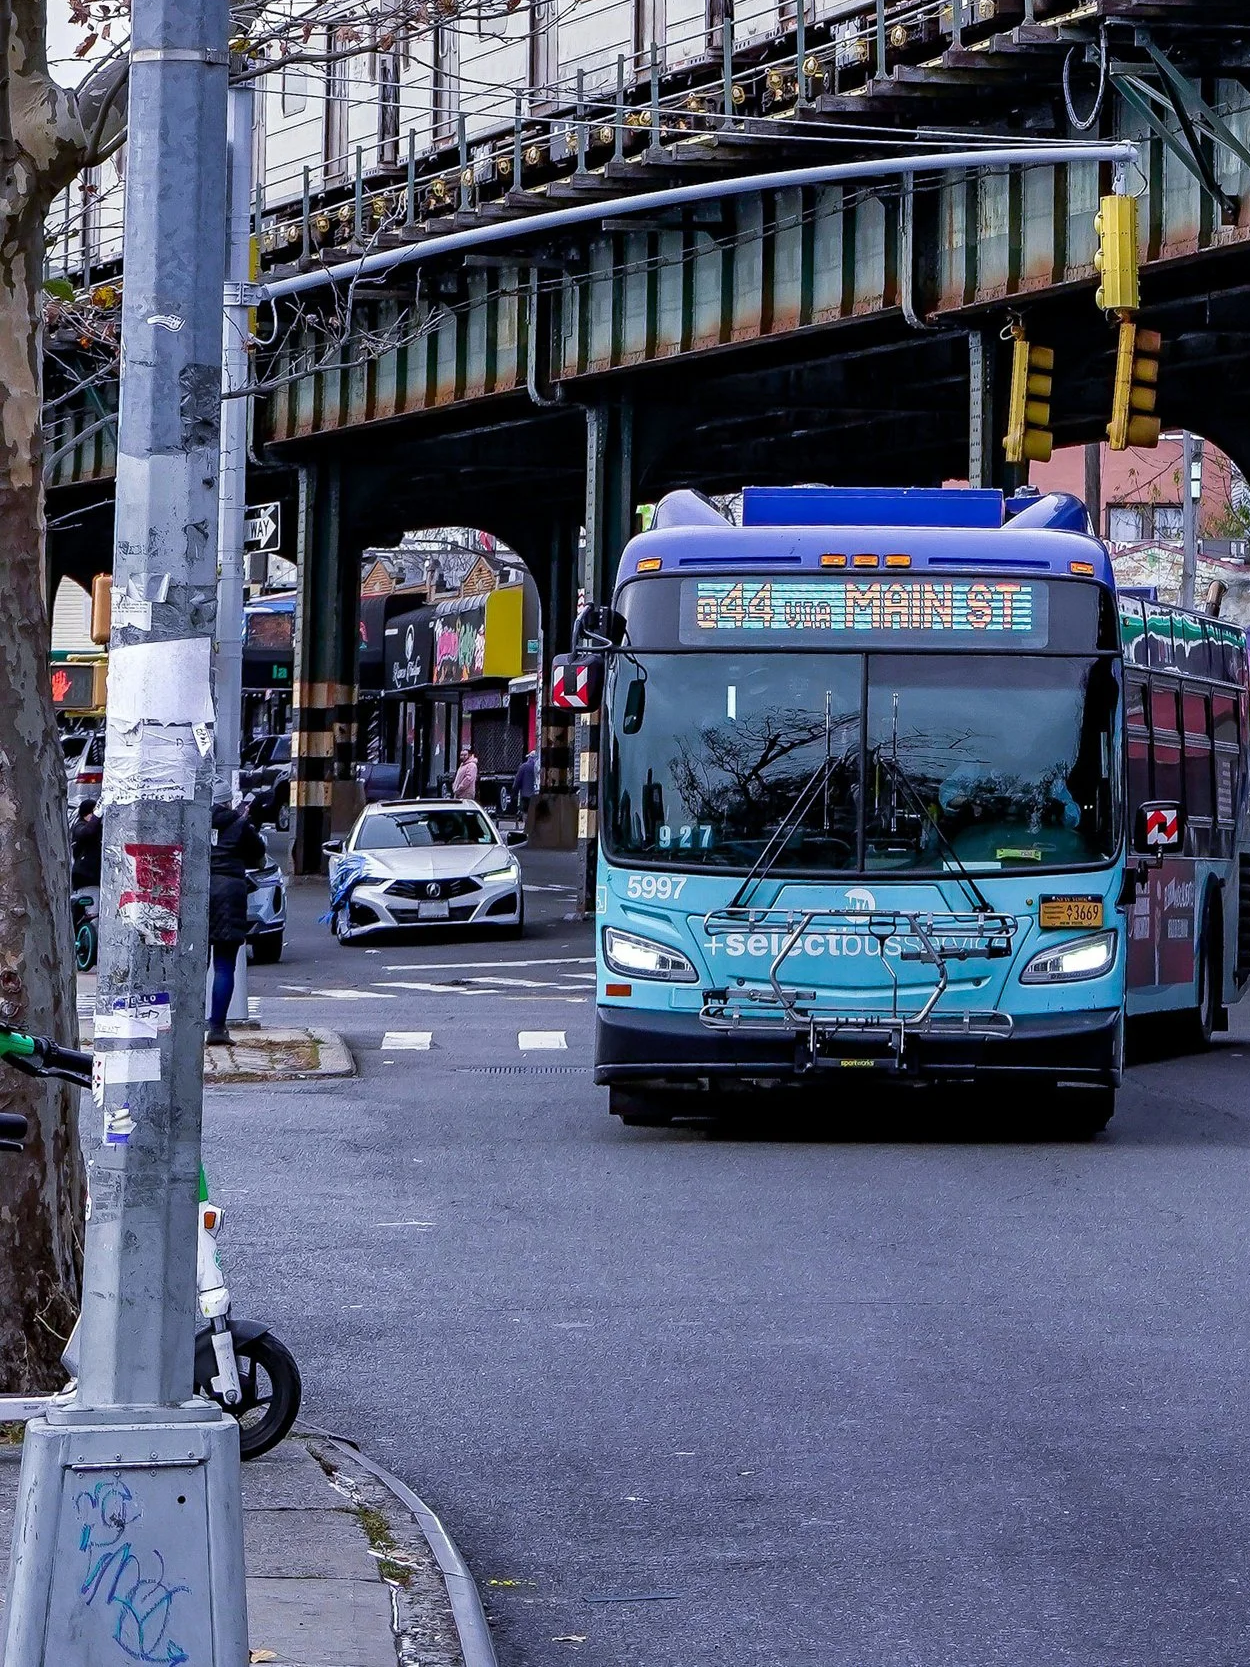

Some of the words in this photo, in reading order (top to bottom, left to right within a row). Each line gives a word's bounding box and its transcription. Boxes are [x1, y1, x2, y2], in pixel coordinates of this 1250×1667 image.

[251, 520, 270, 538] WAY
[846, 583, 952, 628] MAIN
[965, 583, 1020, 628] ST
[627, 875, 688, 900] 5997
